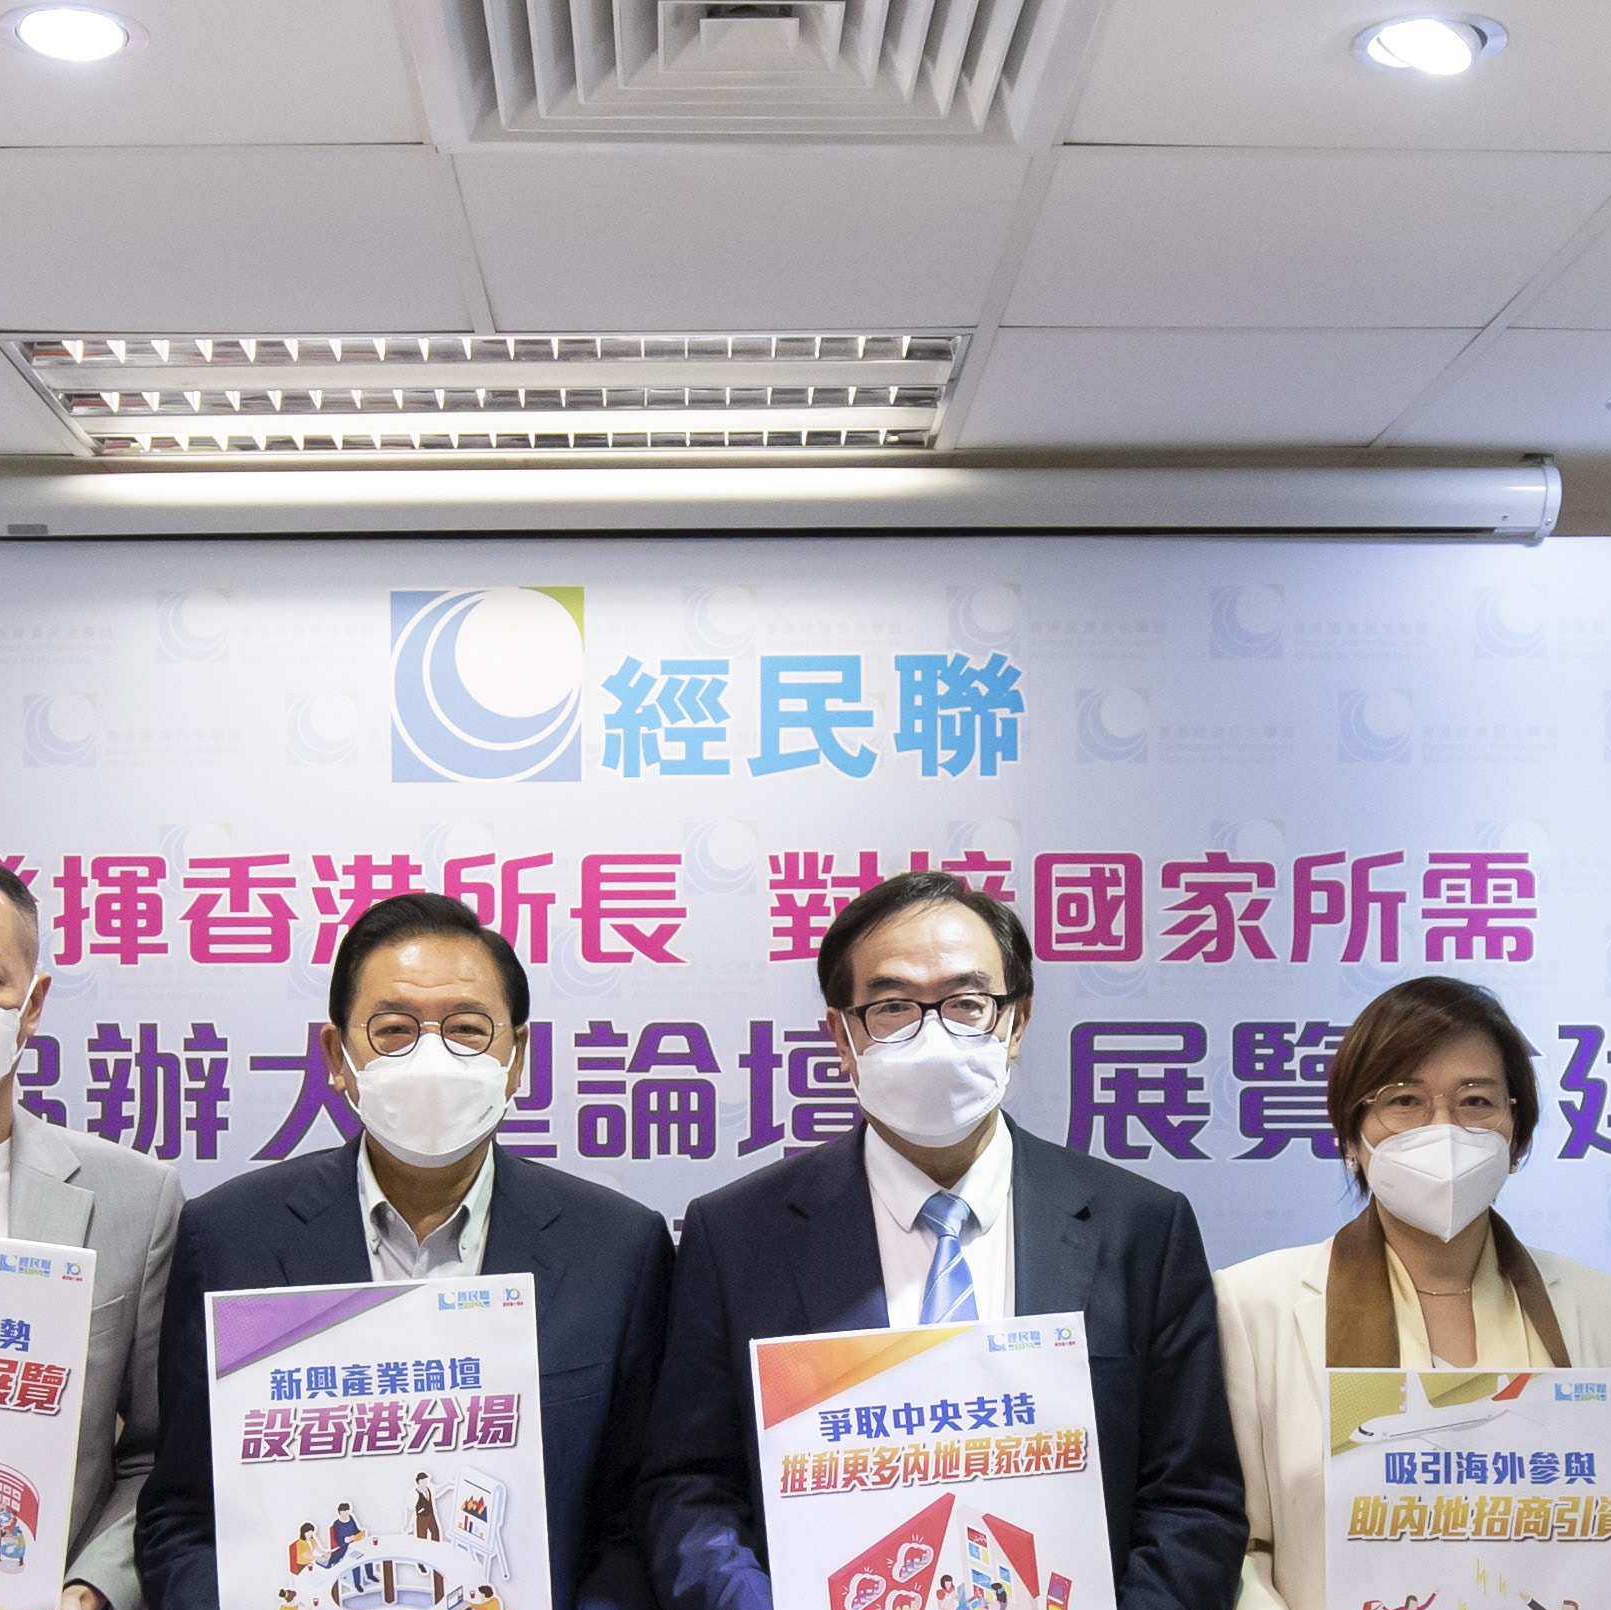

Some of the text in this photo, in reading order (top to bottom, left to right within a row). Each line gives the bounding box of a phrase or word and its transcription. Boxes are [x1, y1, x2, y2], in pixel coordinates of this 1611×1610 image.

[600, 651, 1026, 779] 經民聯
[768, 849, 1539, 962] 對國家所需
[270, 1357, 482, 1401] 新興產業論壇
[240, 1393, 518, 1461] 設香港分場
[819, 1392, 1036, 1442] 爭取中央支持
[779, 1429, 1087, 1495] 推動更多內地買家來港
[1385, 1451, 1598, 1486] 吸引海外參與
